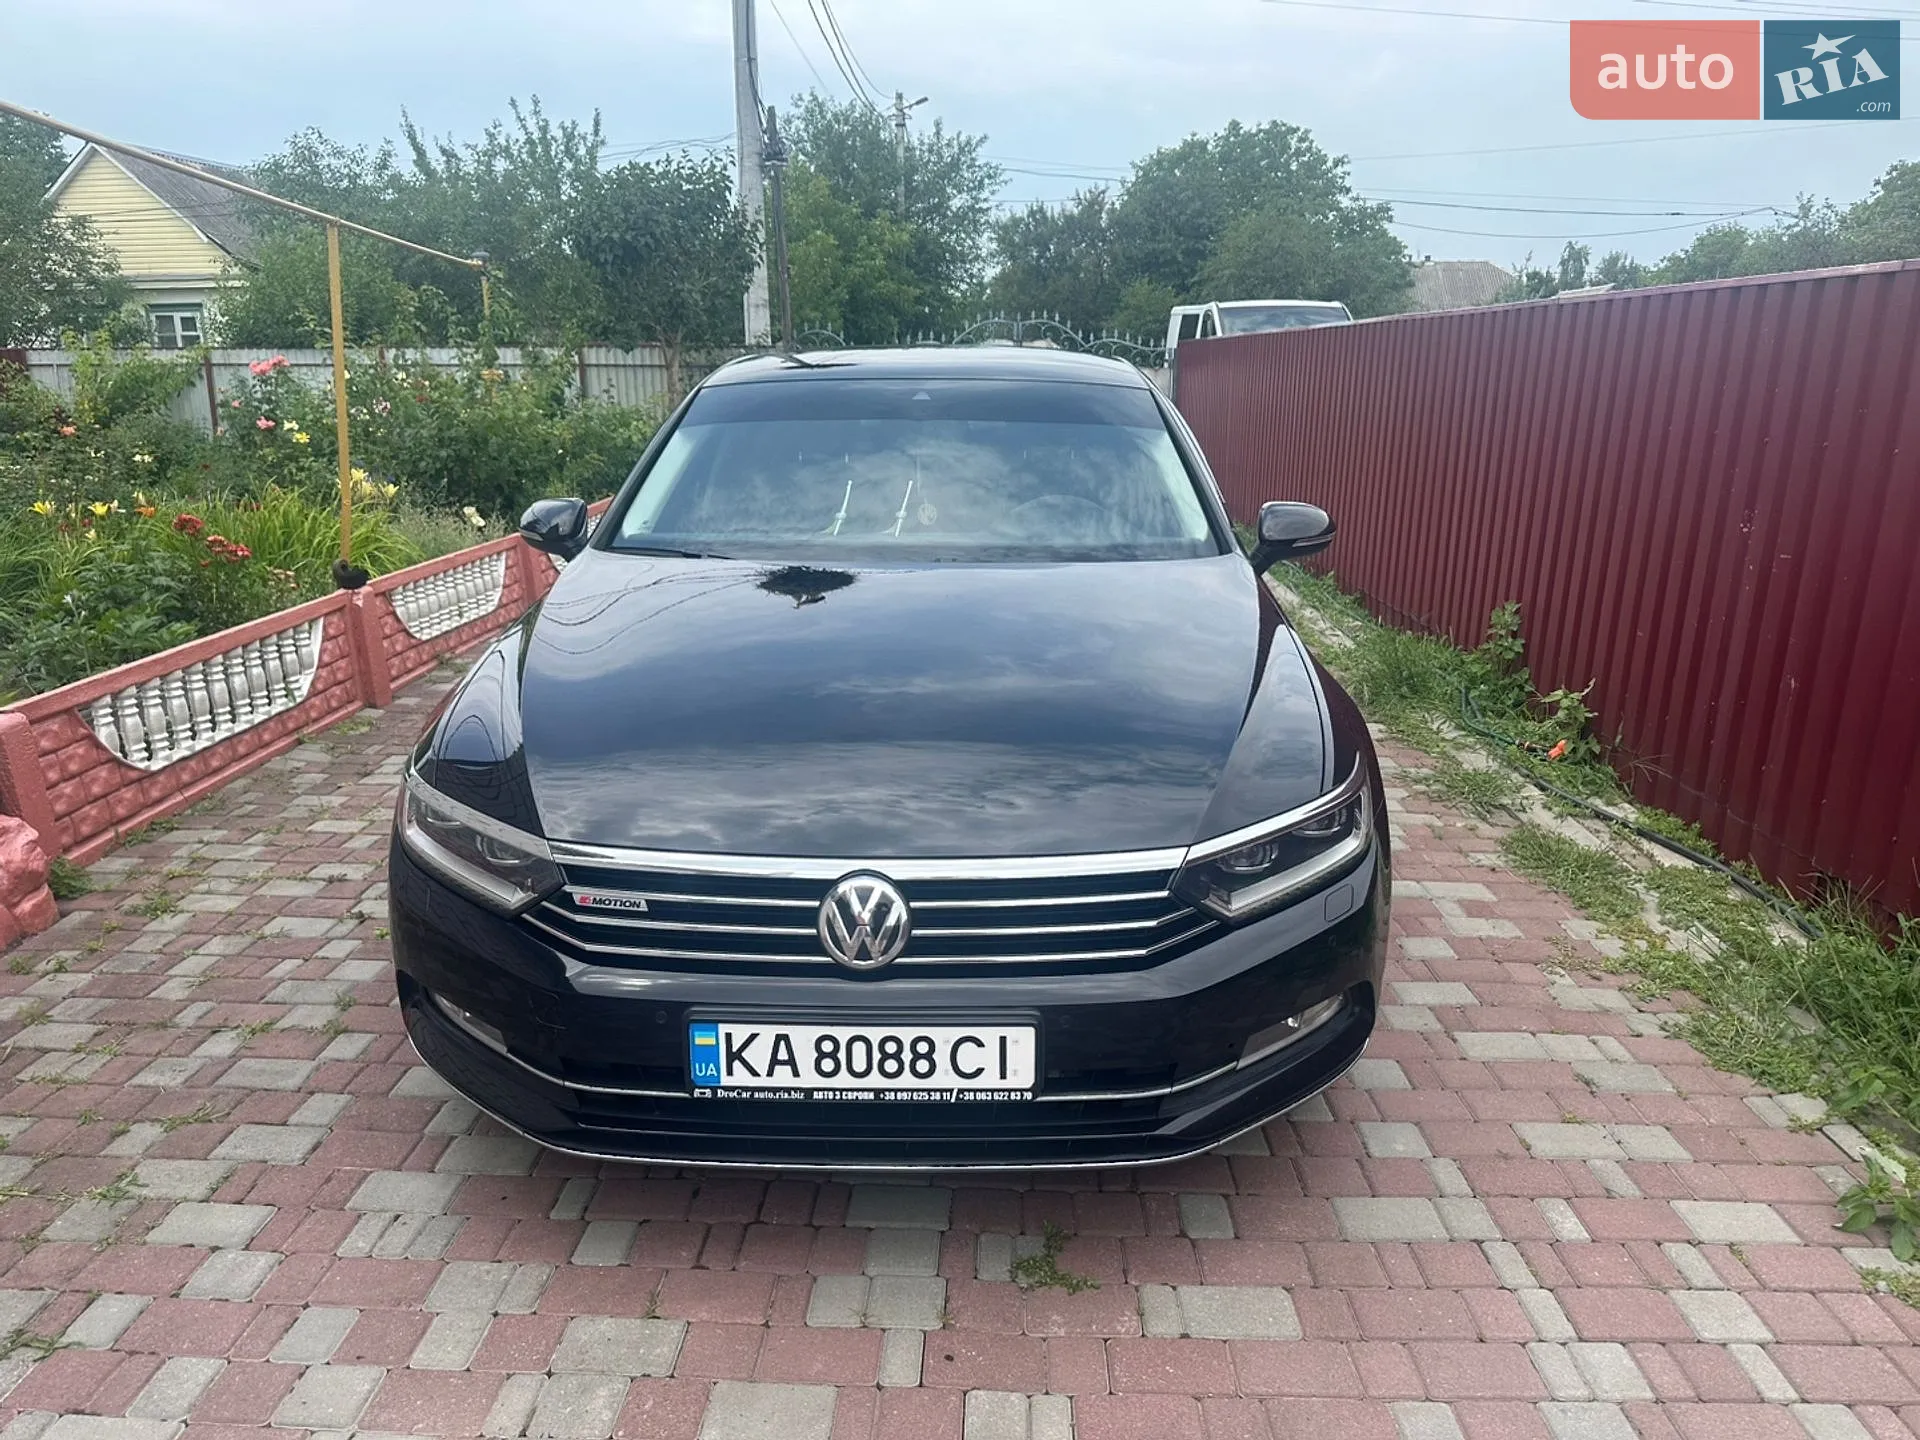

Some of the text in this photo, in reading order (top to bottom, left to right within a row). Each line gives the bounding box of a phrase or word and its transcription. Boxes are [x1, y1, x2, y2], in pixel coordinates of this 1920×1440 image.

[695, 1063, 718, 1077] UA
[724, 1032, 1008, 1080] KA 8088 CI
